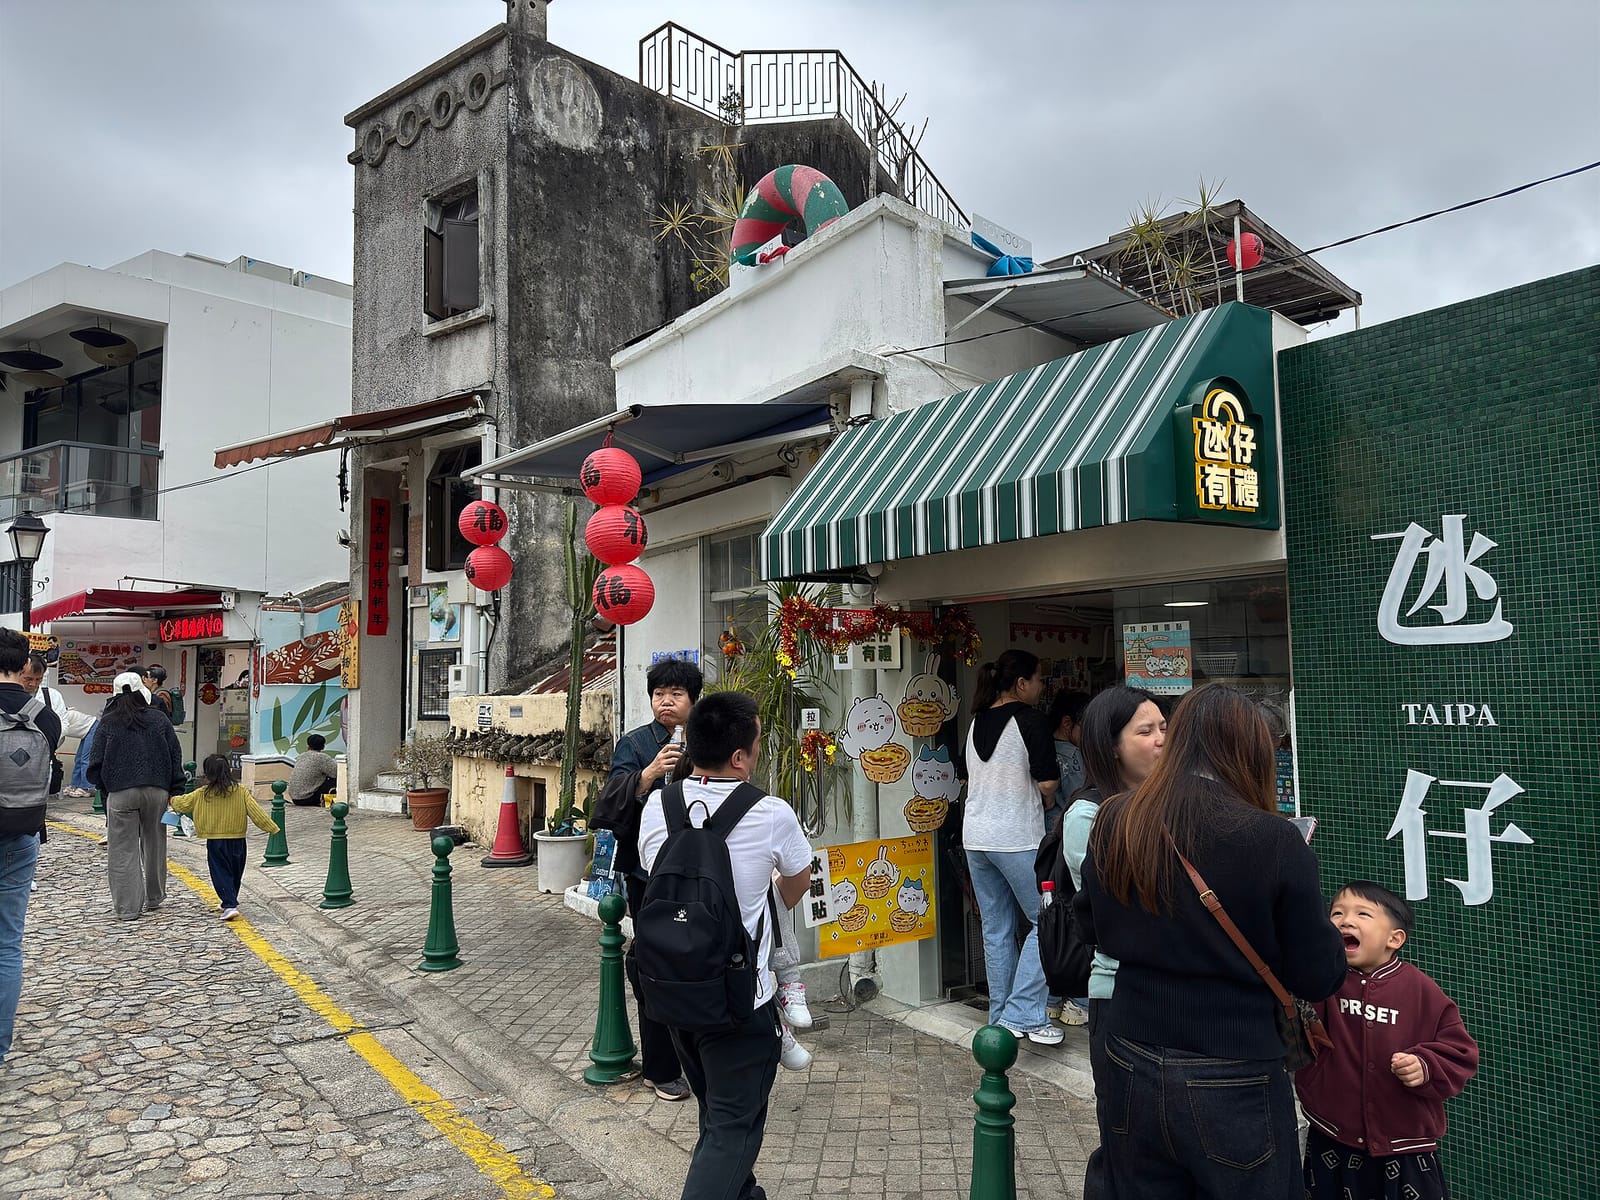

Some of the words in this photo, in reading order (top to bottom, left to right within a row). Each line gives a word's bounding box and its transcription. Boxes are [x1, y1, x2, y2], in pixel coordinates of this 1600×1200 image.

[1197, 420, 1256, 465] 氹仔
[1200, 463, 1259, 508] 有禮
[473, 505, 503, 533] 福
[595, 574, 632, 610] 福
[1370, 514, 1513, 645] 氹
[862, 644, 892, 663] 有禮
[806, 711, 816, 722] 拉
[1402, 704, 1498, 726] TAIPA
[1385, 768, 1534, 905] 仔
[1339, 998, 1399, 1025] PRSET
